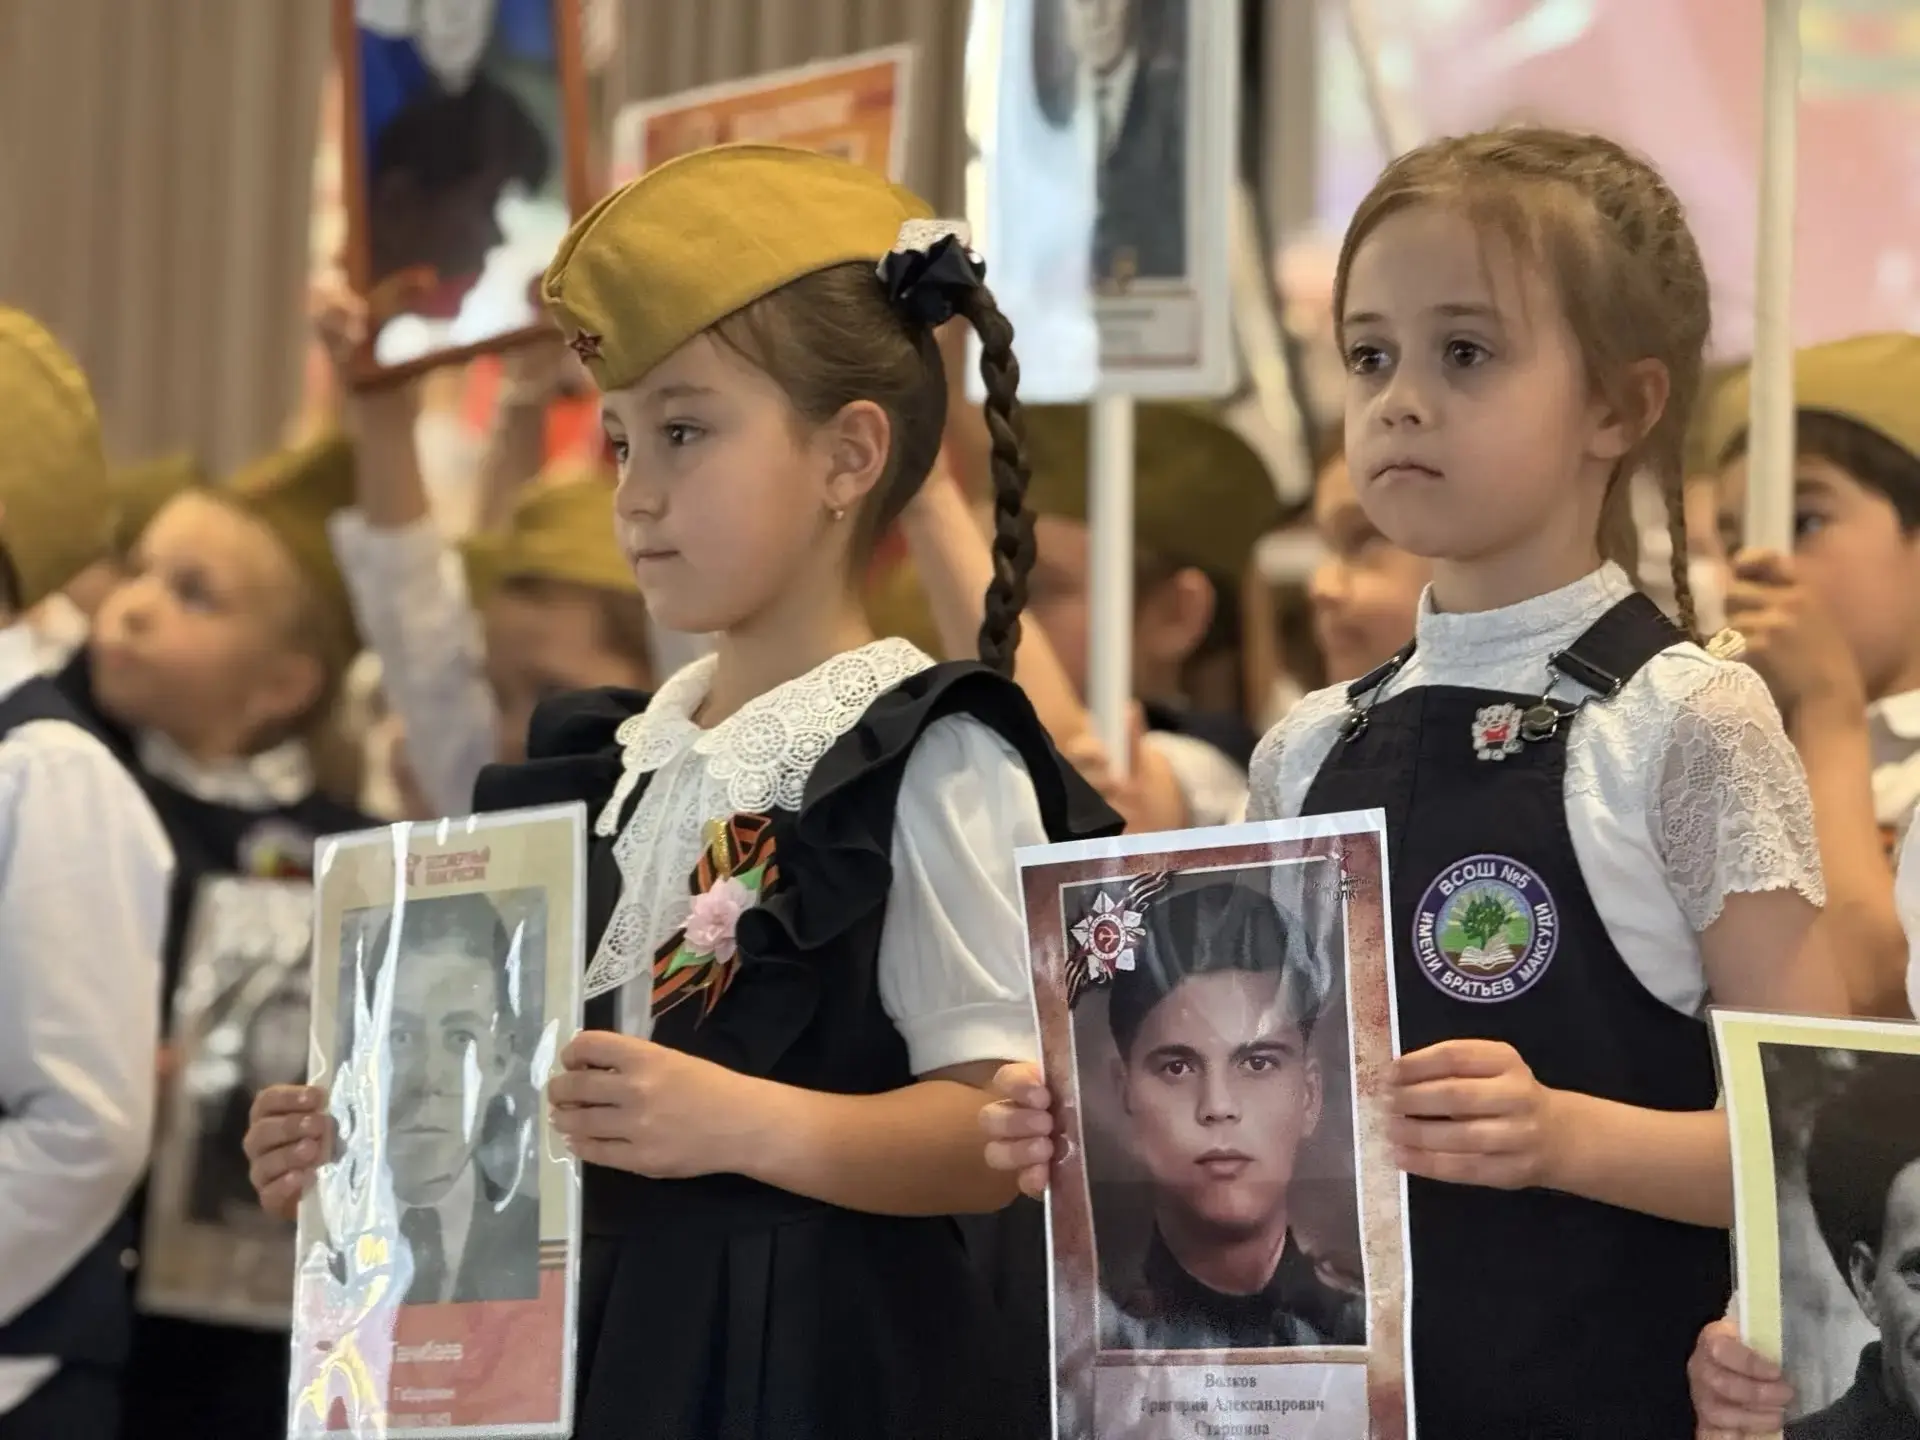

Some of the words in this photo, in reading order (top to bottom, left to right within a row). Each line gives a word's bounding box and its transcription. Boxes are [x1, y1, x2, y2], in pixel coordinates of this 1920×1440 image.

[1438, 861, 1496, 896] ВСОШ
[1500, 864, 1531, 889] №5
[1418, 911, 1443, 973] ИМЕНИ
[1441, 972, 1515, 997] БРАТЬЕВ
[1517, 902, 1555, 982] МАКСУДИ
[1204, 1372, 1258, 1389] Волков
